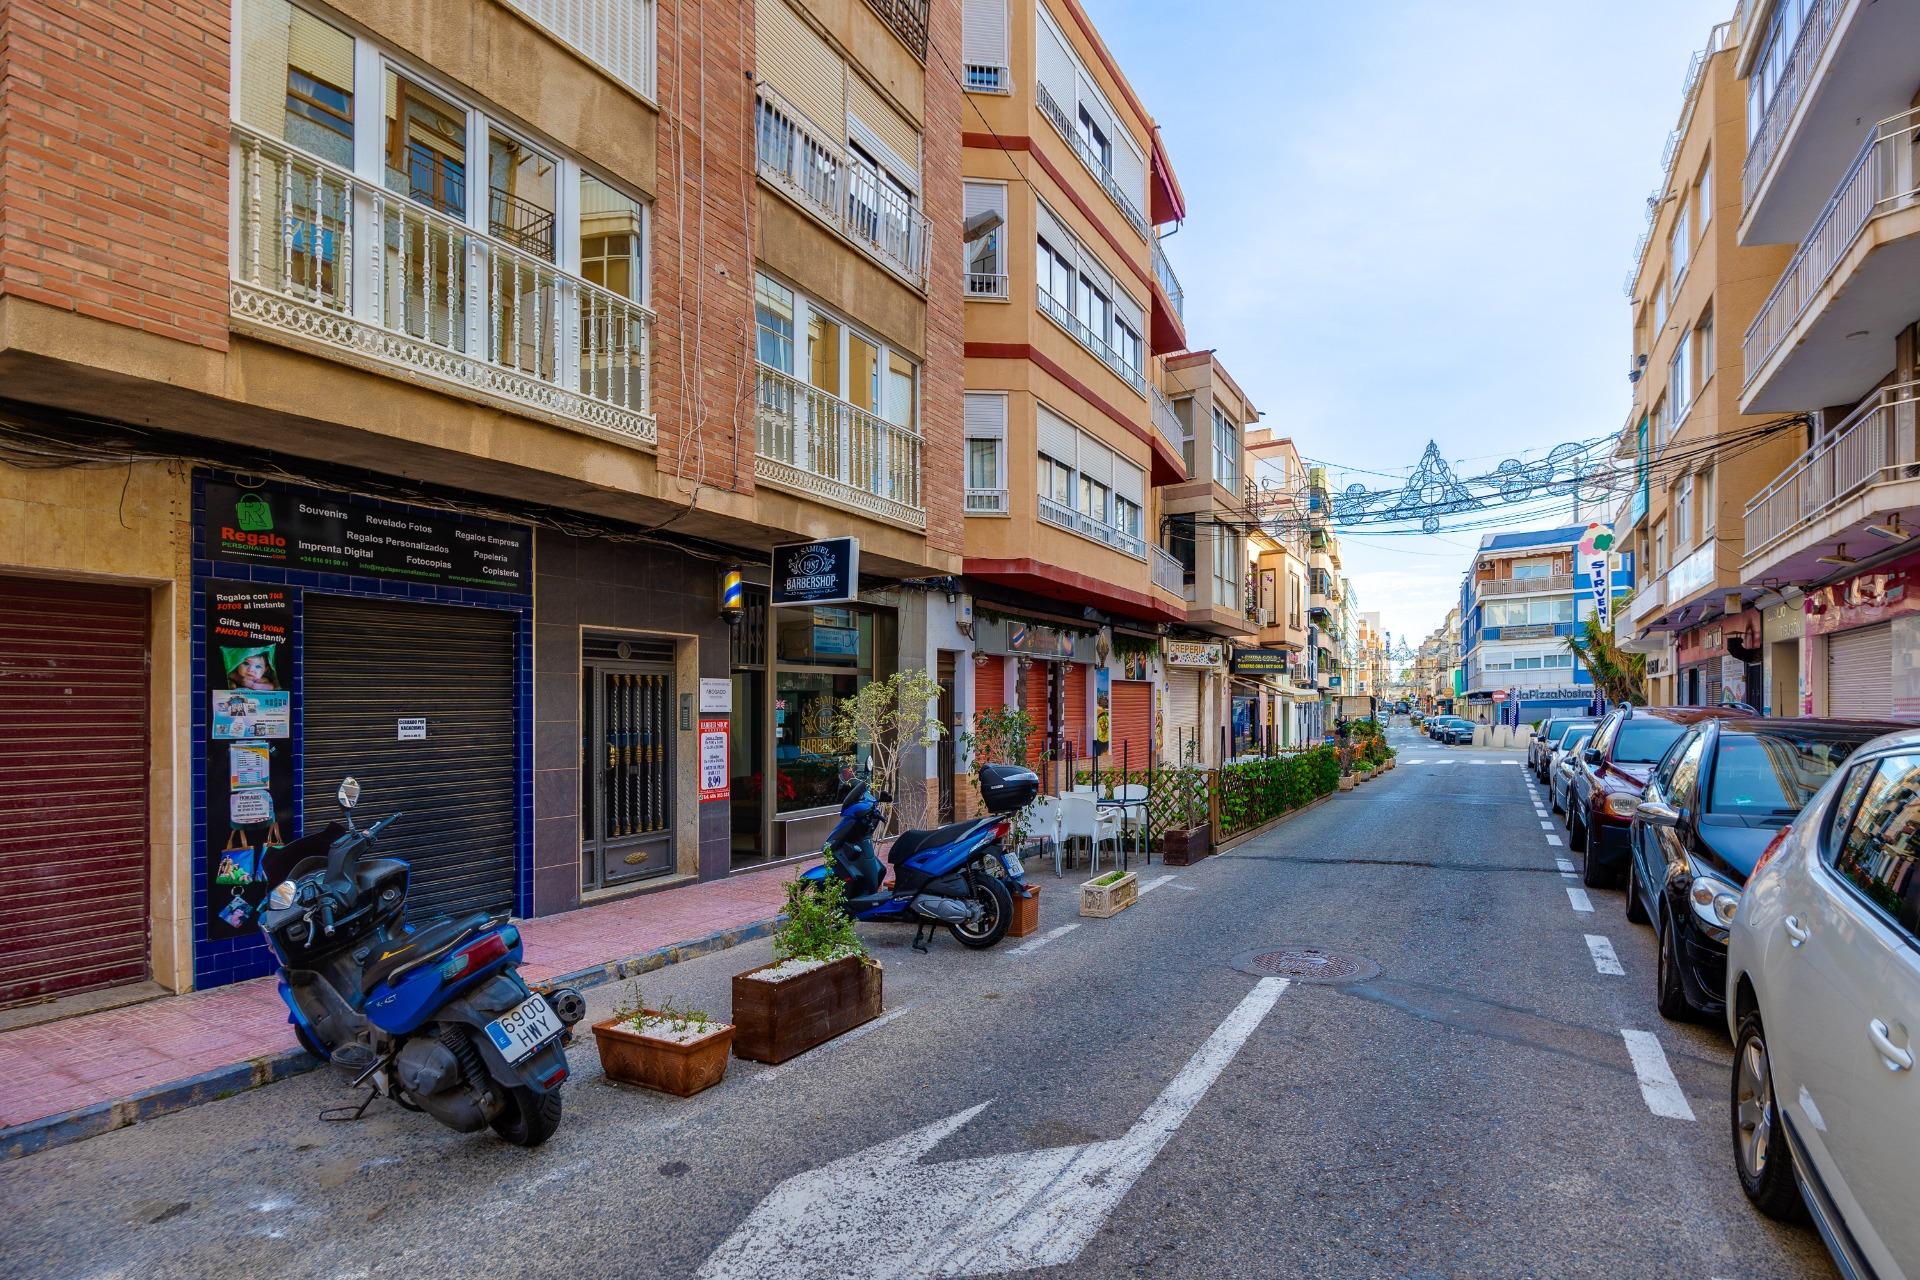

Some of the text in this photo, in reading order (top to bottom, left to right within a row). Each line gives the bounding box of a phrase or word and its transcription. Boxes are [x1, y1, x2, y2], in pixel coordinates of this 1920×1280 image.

[299, 504, 348, 520] Souvenirs
[366, 515, 433, 533] Revelado Fotos
[221, 527, 286, 547] Regalo
[346, 530, 449, 554] Regalos Personalizados
[455, 530, 519, 548] Regalos Empresa
[221, 542, 286, 554] PERSONALIZADO
[298, 540, 374, 558] Imprenta Digital
[800, 545, 830, 556] SAMUEL
[406, 555, 452, 569] Fotocopias
[803, 559, 820, 571] 1987
[216, 594, 251, 602] Regalos
[1591, 560, 1606, 624] SIRVENT
[253, 601, 286, 609] instante
[219, 617, 241, 627] Gifts
[242, 622, 261, 630] with
[215, 626, 286, 643] PHOTOS instantly
[1170, 644, 1206, 654] CREPERIA
[501, 998, 546, 1033] 6900
[516, 1016, 550, 1047] HWY
